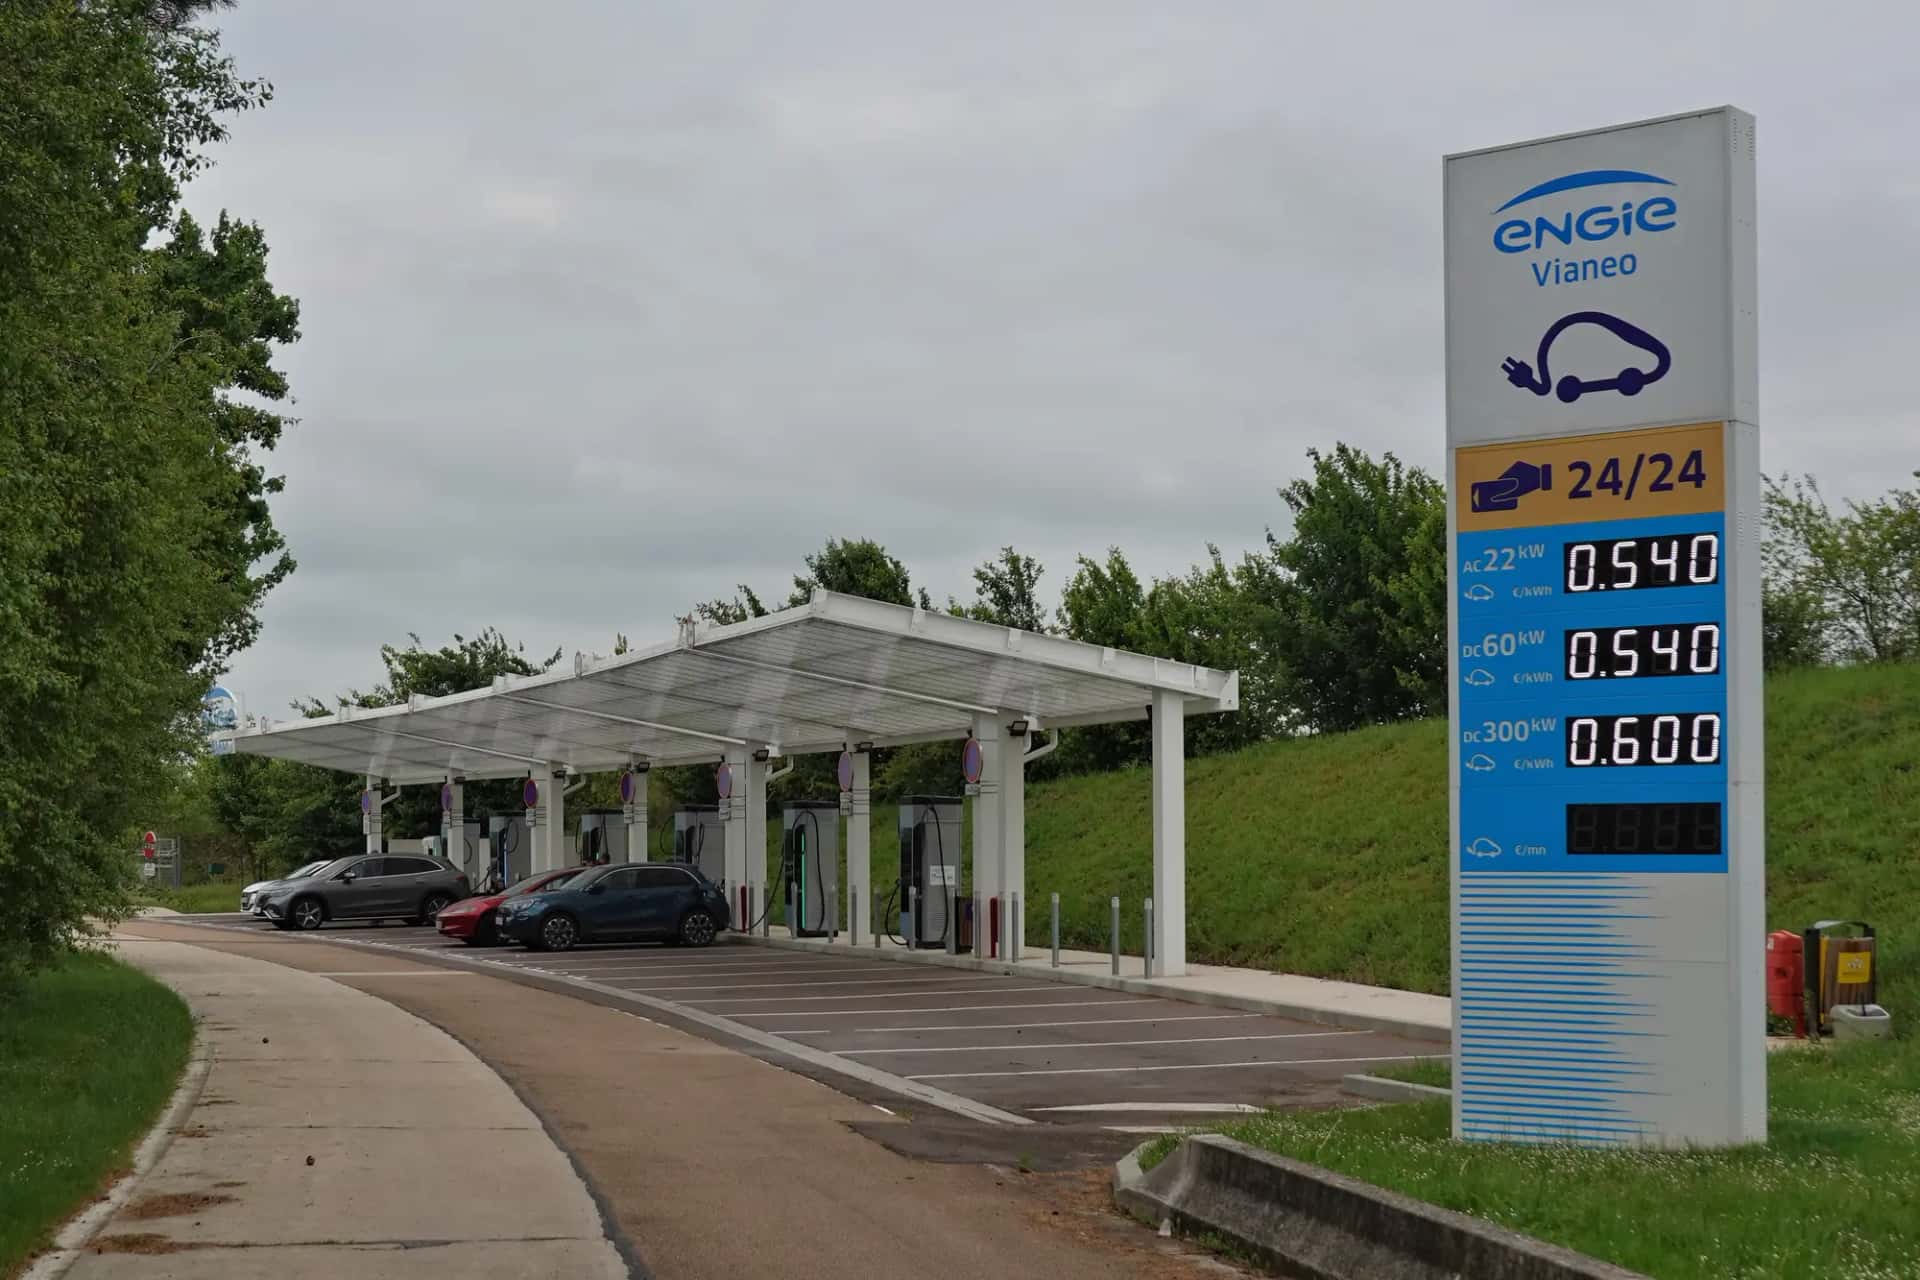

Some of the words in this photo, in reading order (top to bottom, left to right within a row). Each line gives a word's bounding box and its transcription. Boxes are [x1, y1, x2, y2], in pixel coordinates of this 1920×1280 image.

[1532, 253, 1637, 286] Vianeo
[1568, 450, 1706, 500] 24/24
[1568, 535, 1719, 592] 0.540
[1569, 624, 1719, 678] 0.540
[1513, 671, 1553, 685] €/kWh
[1514, 758, 1554, 770] €/kWh
[1570, 714, 1720, 765] 0.600
